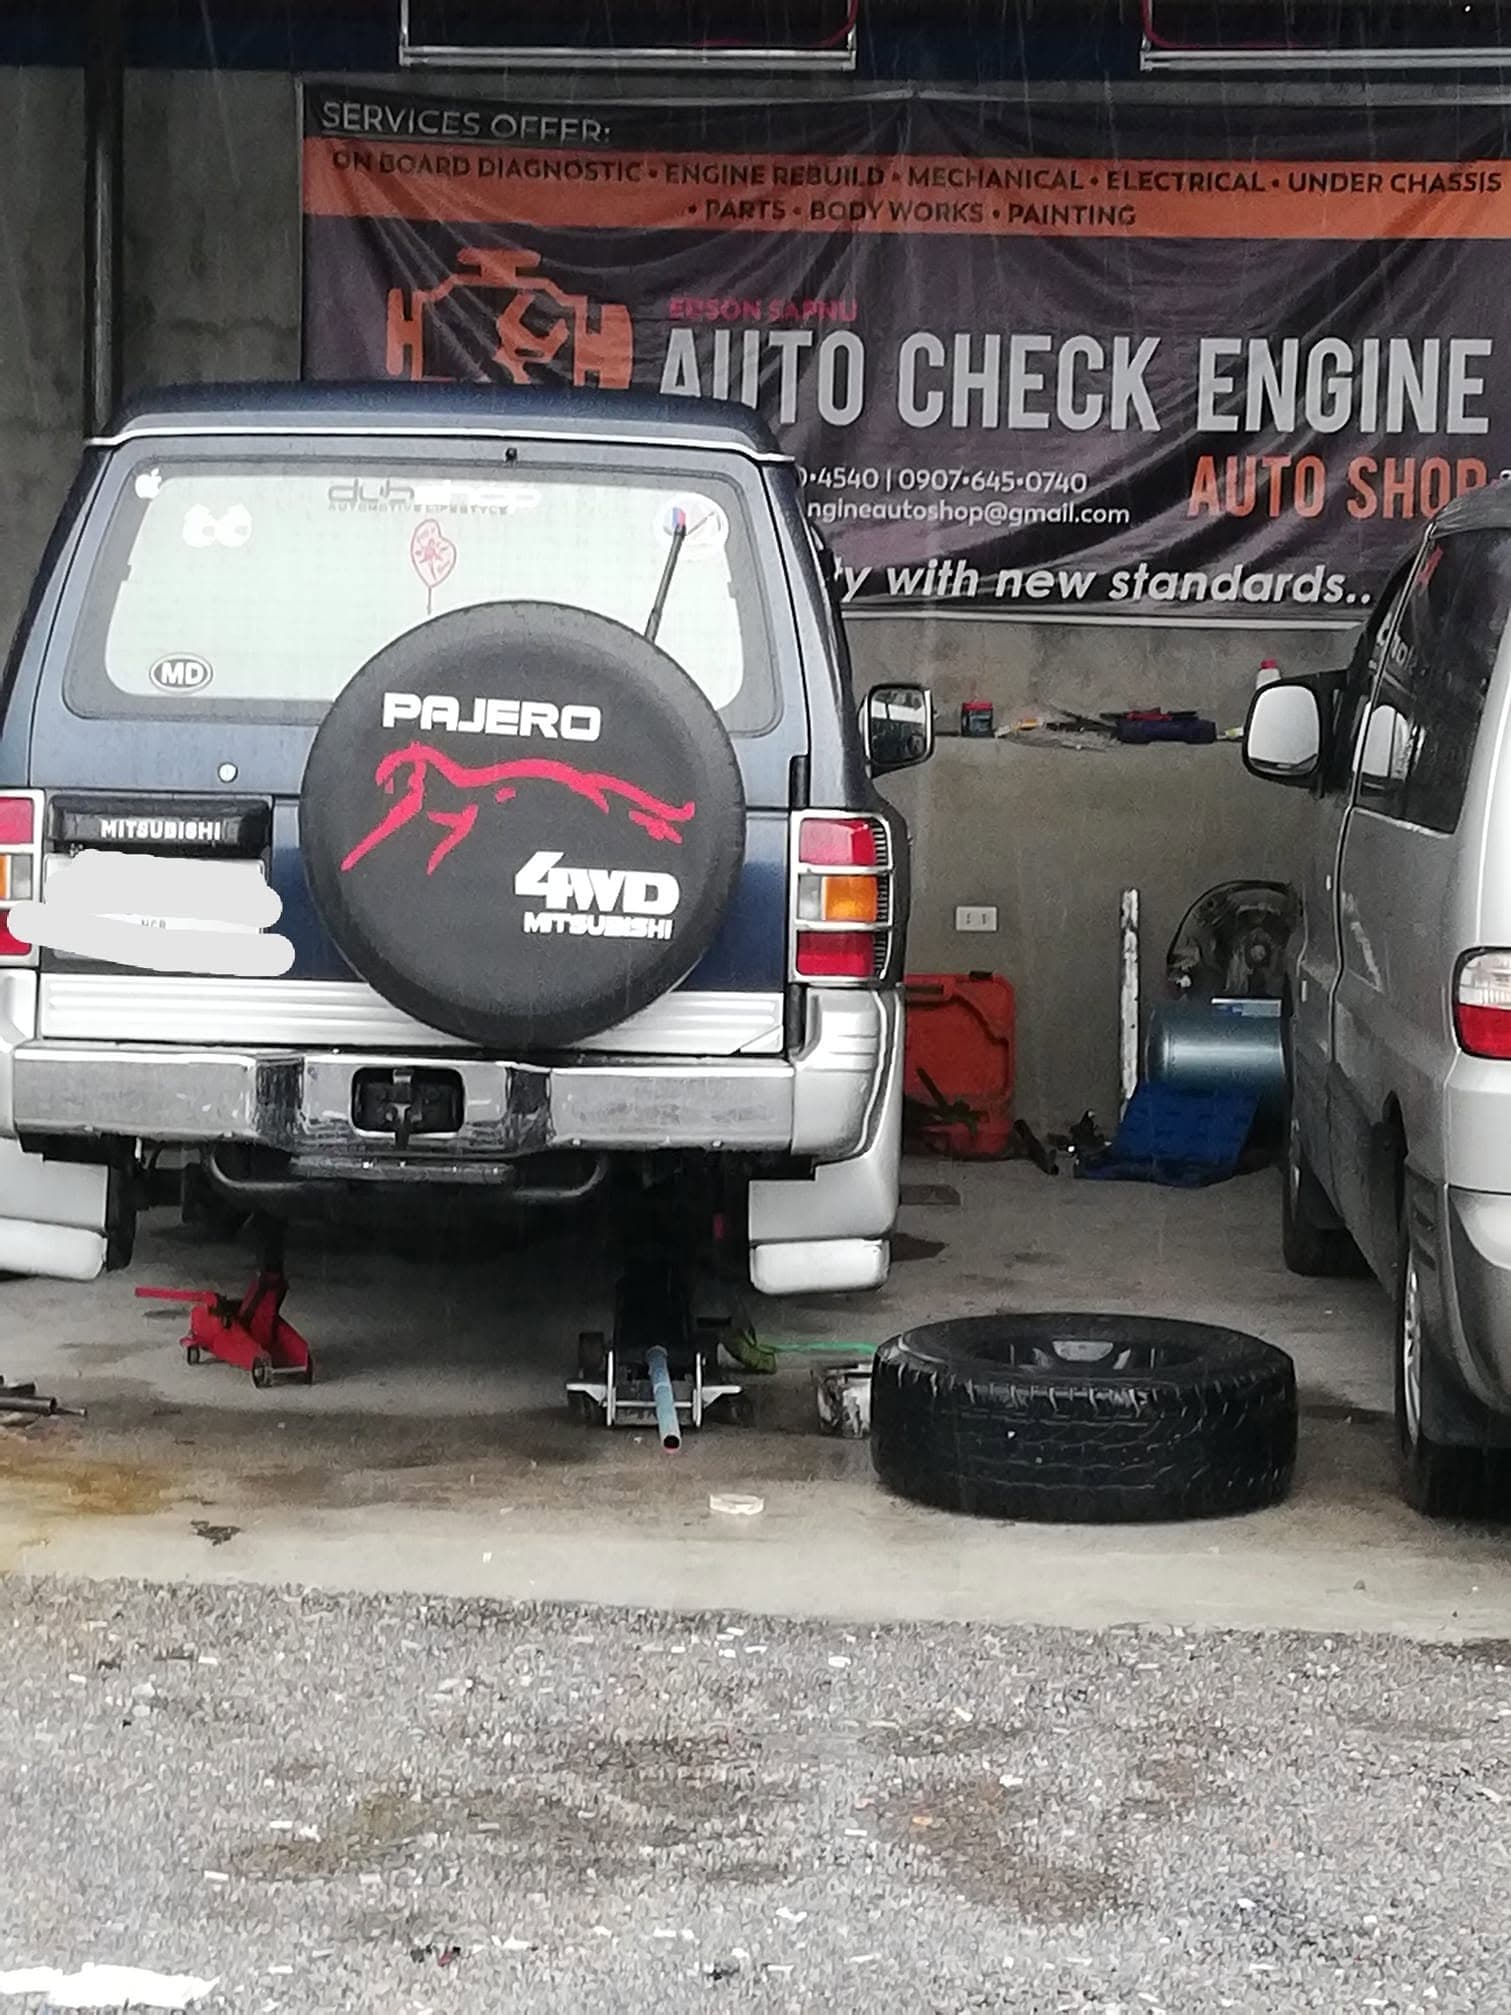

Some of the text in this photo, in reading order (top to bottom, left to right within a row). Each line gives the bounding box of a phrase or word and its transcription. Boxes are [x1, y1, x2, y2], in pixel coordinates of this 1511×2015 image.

[321, 101, 610, 143] SERVICES OFFER:
[332, 152, 1502, 194] ON BOARD DIAGNOSTIC ENGINE REBUILD MECHANICAL ELECTRICAL UNDER CHASSIS
[704, 200, 1136, 226] PARTS BODY WORKS PAINTING
[660, 328, 1492, 433] AUTO CHECK ENGINE
[1187, 455, 1326, 519] AUTO
[808, 499, 1130, 526] ngineautoshop@gmail.com
[887, 558, 979, 598] with
[995, 567, 1097, 600] new
[161, 661, 205, 685] MD
[382, 692, 601, 742] PAJERO
[101, 819, 221, 841] MITSUBISHI
[514, 850, 680, 915] 4WD
[523, 911, 673, 940] MITSUBISHI
